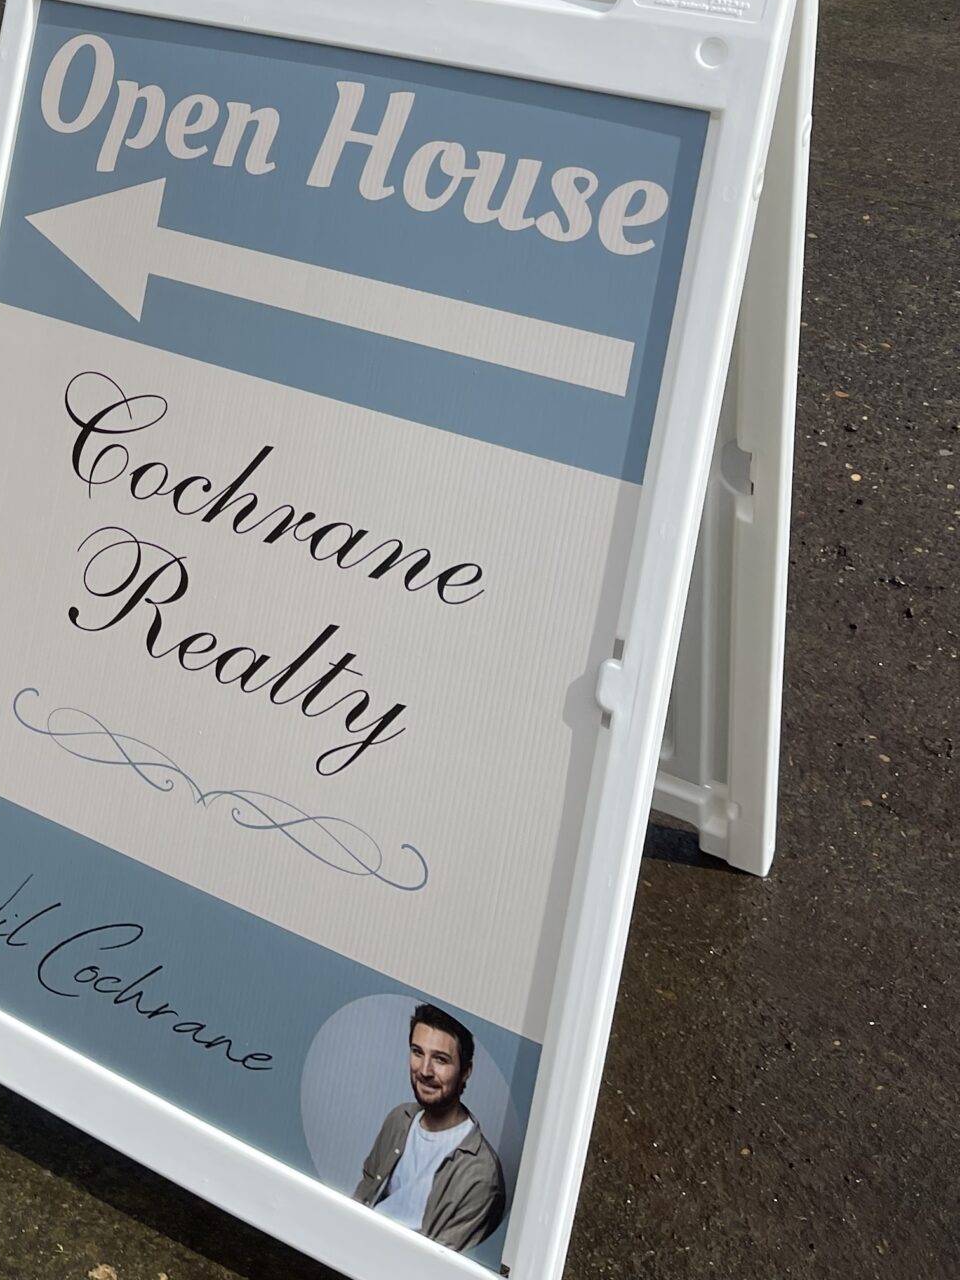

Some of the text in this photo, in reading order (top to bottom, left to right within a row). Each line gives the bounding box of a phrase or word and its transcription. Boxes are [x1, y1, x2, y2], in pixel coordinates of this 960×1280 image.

[39, 33, 670, 257] Open House
[64, 371, 485, 606] Cochrane
[67, 526, 407, 777] Realty
[37, 922, 275, 1073] Cochrane
